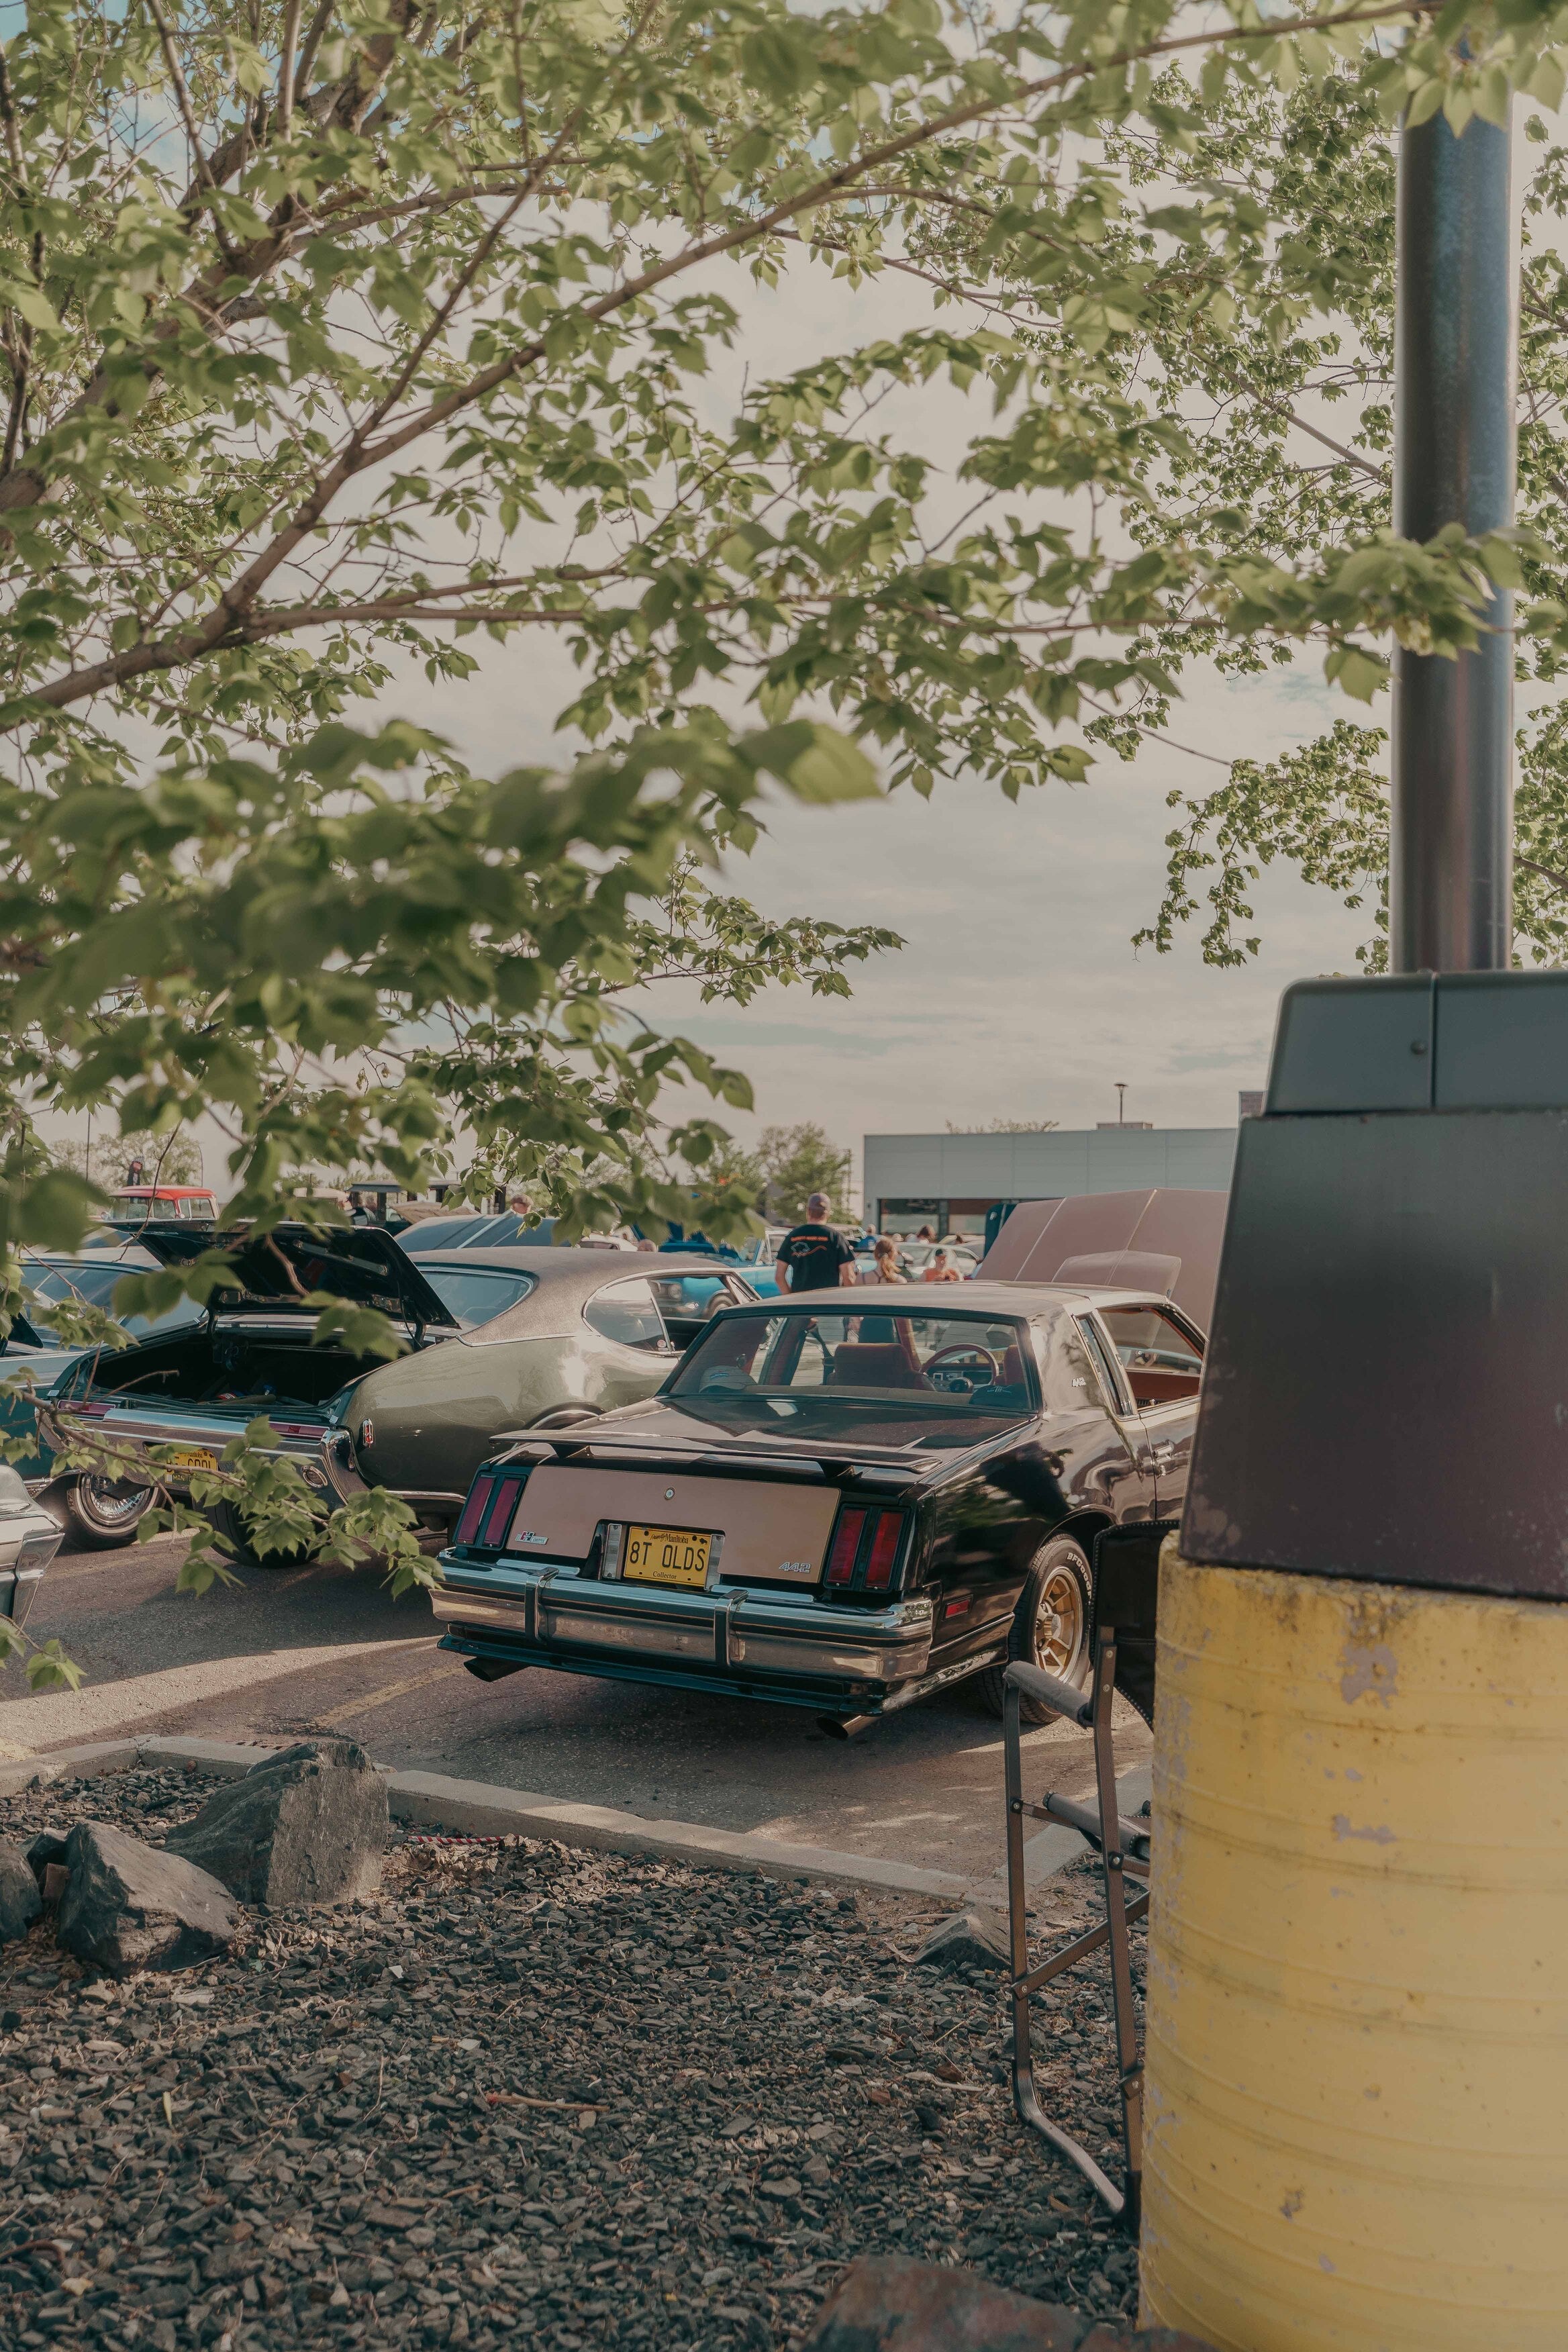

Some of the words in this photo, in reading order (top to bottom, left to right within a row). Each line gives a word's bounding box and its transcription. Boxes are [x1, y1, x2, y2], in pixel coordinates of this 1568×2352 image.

[665, 1533, 689, 1544] Manitoba
[630, 1540, 652, 1565] 8T
[662, 1544, 705, 1571] OLDS
[779, 1561, 812, 1573] 442
[652, 1571, 677, 1579] Collector
